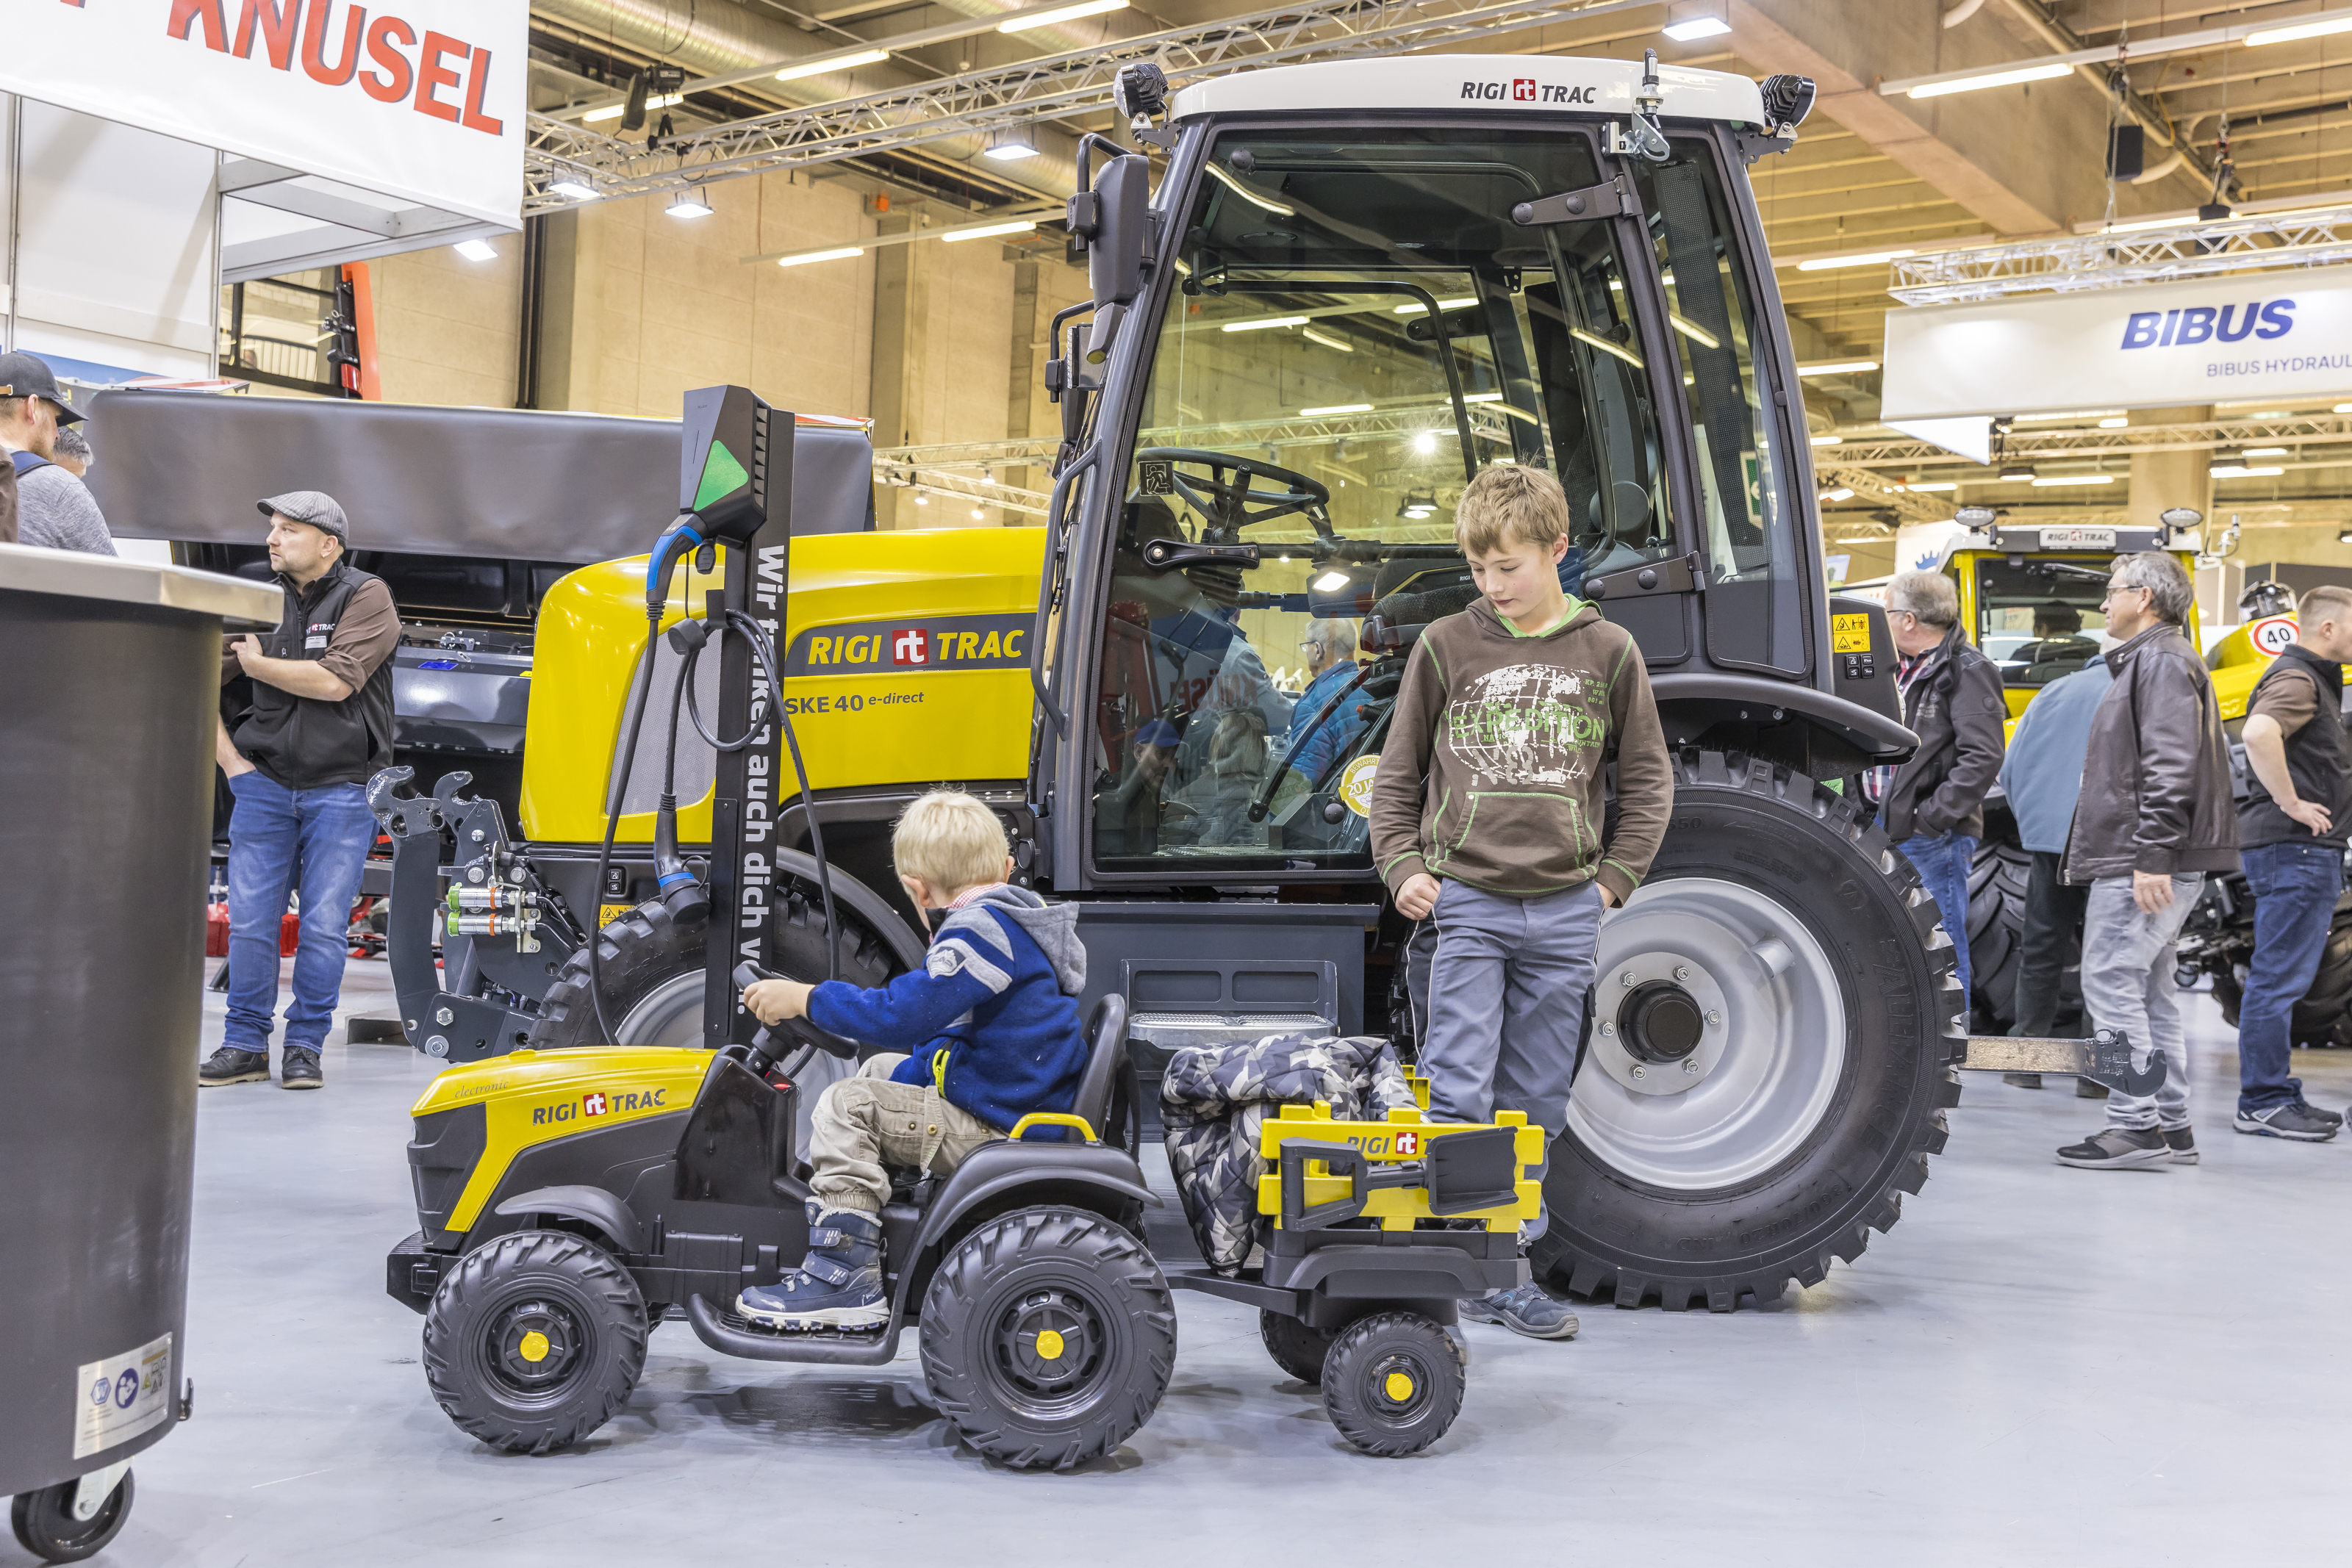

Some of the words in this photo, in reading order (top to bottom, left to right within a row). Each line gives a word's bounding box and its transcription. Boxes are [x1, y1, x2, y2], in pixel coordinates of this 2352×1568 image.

[1460, 82, 1507, 100] RIGI
[1541, 84, 1596, 104] TRAC
[2120, 299, 2296, 350] BIBUS
[2207, 360, 2260, 377] BIBUS
[2046, 533, 2069, 542] RIGI
[2084, 533, 2109, 542] TRAC
[756, 545, 784, 611] Wir
[2267, 627, 2290, 644] 40
[808, 635, 882, 665] RIGI
[936, 630, 1025, 660] TRAC
[784, 697, 830, 714] SKE
[833, 694, 864, 713] 40
[868, 691, 925, 705] e-direct
[1453, 708, 1605, 741] EXPEDITION
[745, 755, 773, 842] auch
[1346, 783, 1363, 796] 20
[742, 852, 771, 928] dich
[454, 1079, 509, 1098] electronic
[532, 1102, 577, 1126] RIGI
[612, 1088, 666, 1112] TRAC
[1347, 1136, 1391, 1154] RIGI
